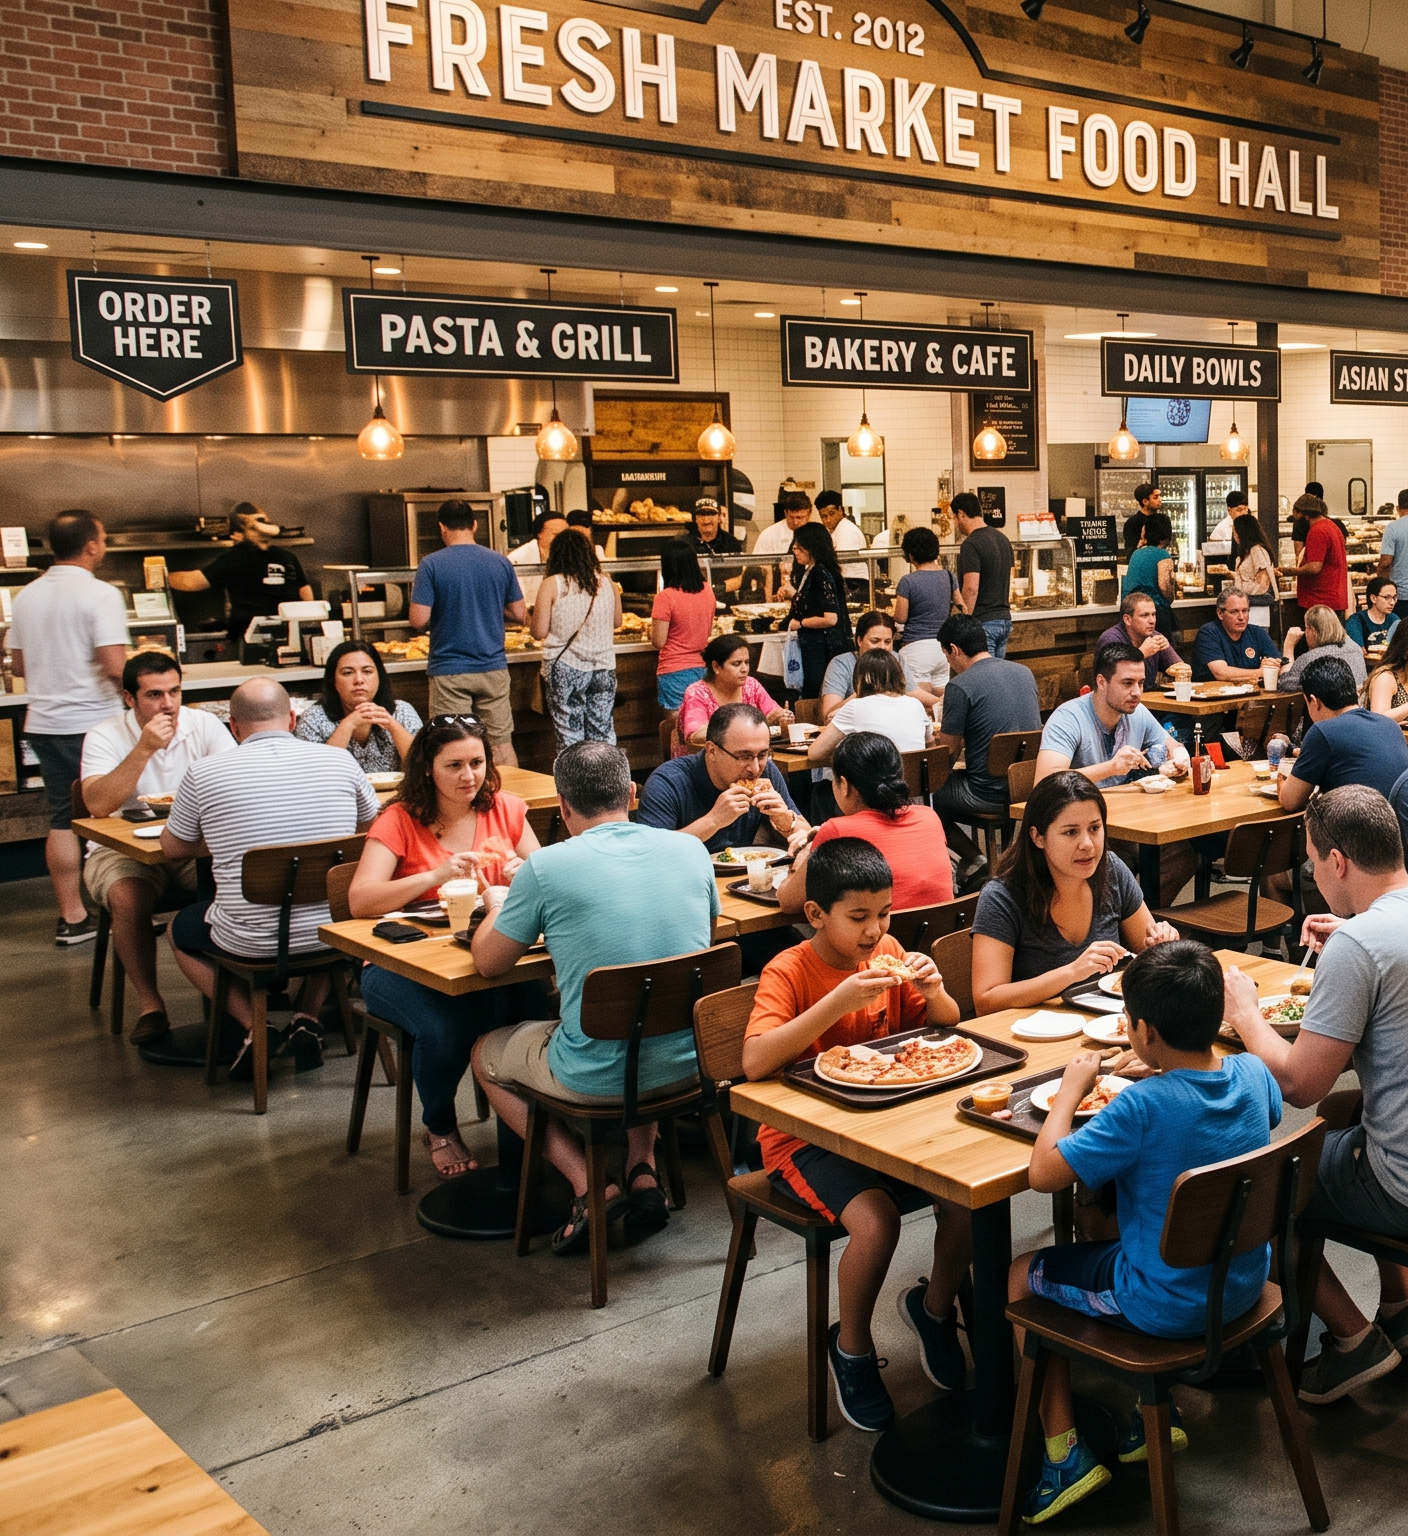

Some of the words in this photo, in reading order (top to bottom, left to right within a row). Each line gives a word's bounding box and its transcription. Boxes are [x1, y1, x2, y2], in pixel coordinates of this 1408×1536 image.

[775, 0, 843, 41] EST.
[853, 12, 925, 57] 2012
[365, 0, 678, 124] FRESH
[716, 44, 1022, 173] MARKET
[1048, 105, 1197, 197] FOOD
[1219, 137, 1340, 220] HALL
[98, 290, 213, 325] ORDER
[113, 326, 203, 359] HERE
[380, 313, 504, 358] PASTA
[515, 320, 542, 359] &
[551, 322, 652, 363] GRILL
[804, 335, 917, 373] BAKERY
[925, 342, 944, 374] &
[952, 343, 1016, 377] CAFE
[1124, 353, 1186, 384] DAILY
[1192, 357, 1262, 388] BOWLS
[1338, 365, 1389, 392] ASIAN
